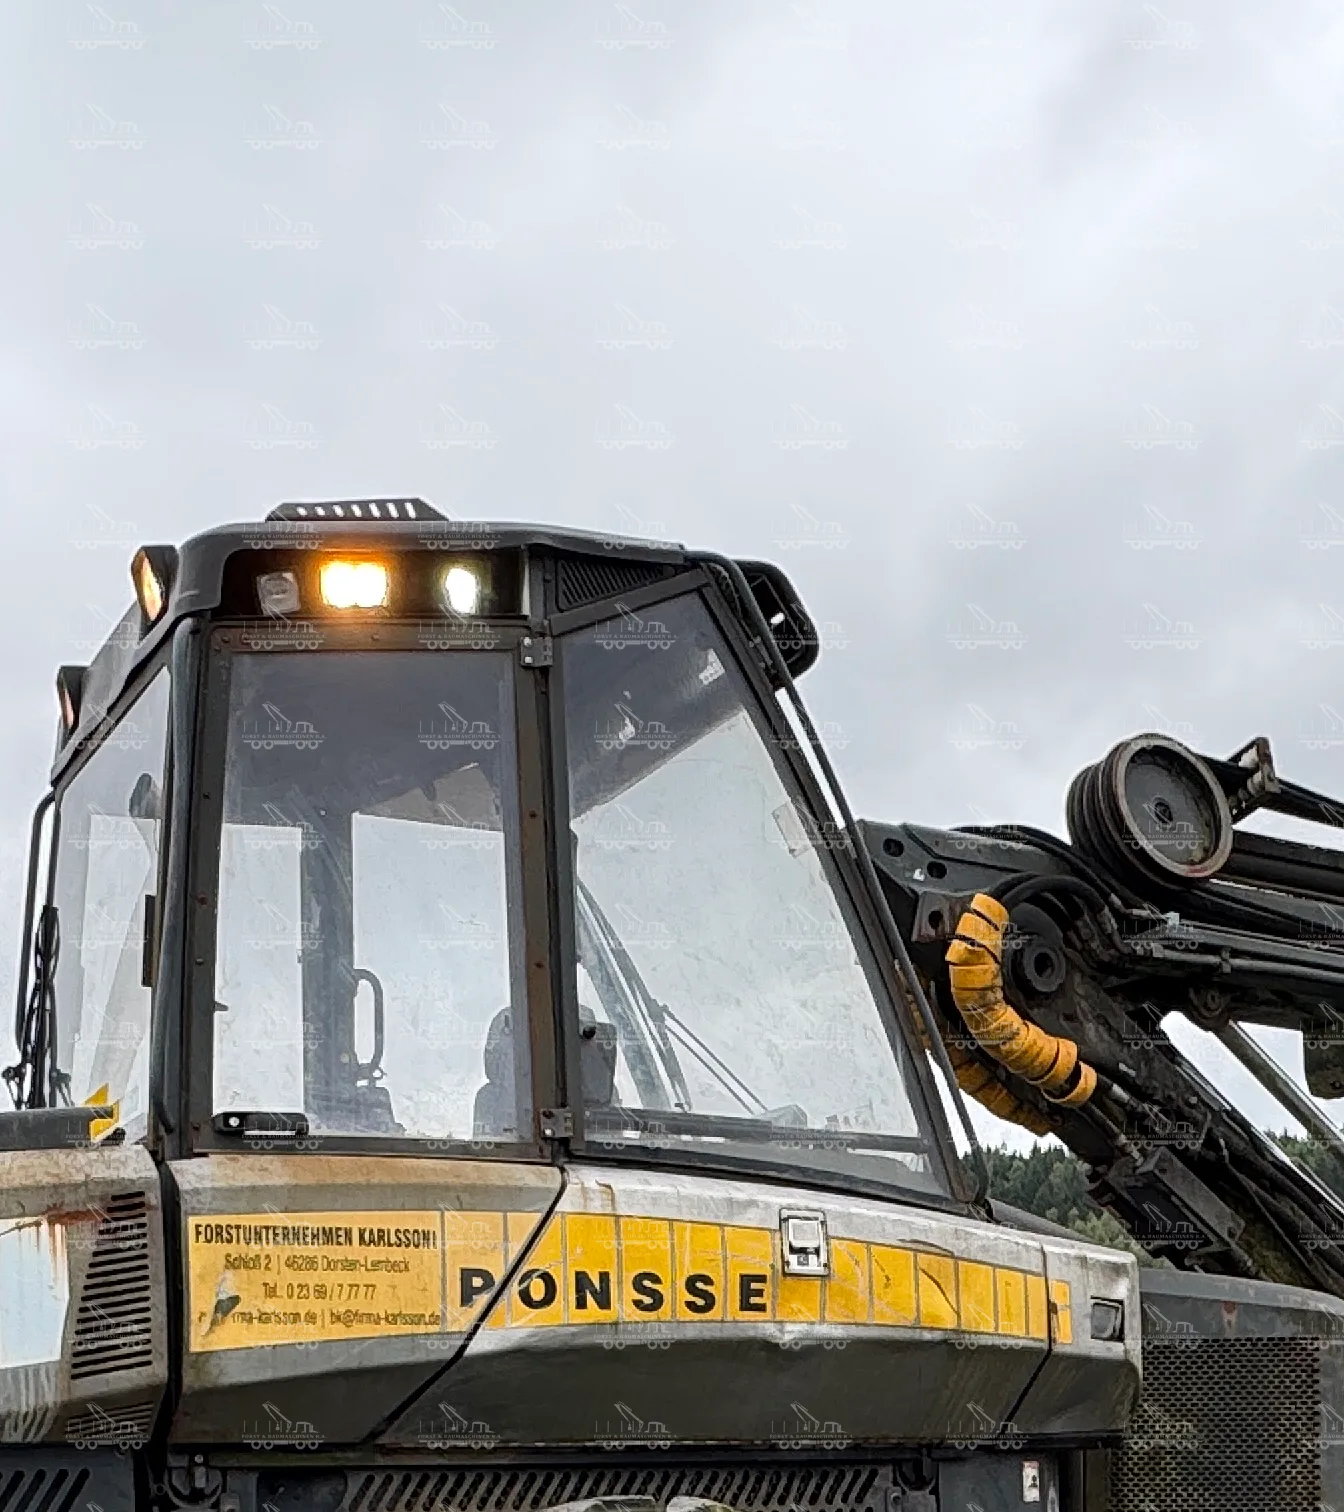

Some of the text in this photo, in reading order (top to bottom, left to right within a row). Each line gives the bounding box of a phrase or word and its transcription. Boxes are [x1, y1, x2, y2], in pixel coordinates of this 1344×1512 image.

[194, 1223, 353, 1247] FORSTUNTERNEHMEN
[264, 1254, 272, 1272] 2
[459, 1266, 768, 1313] PONSSE
